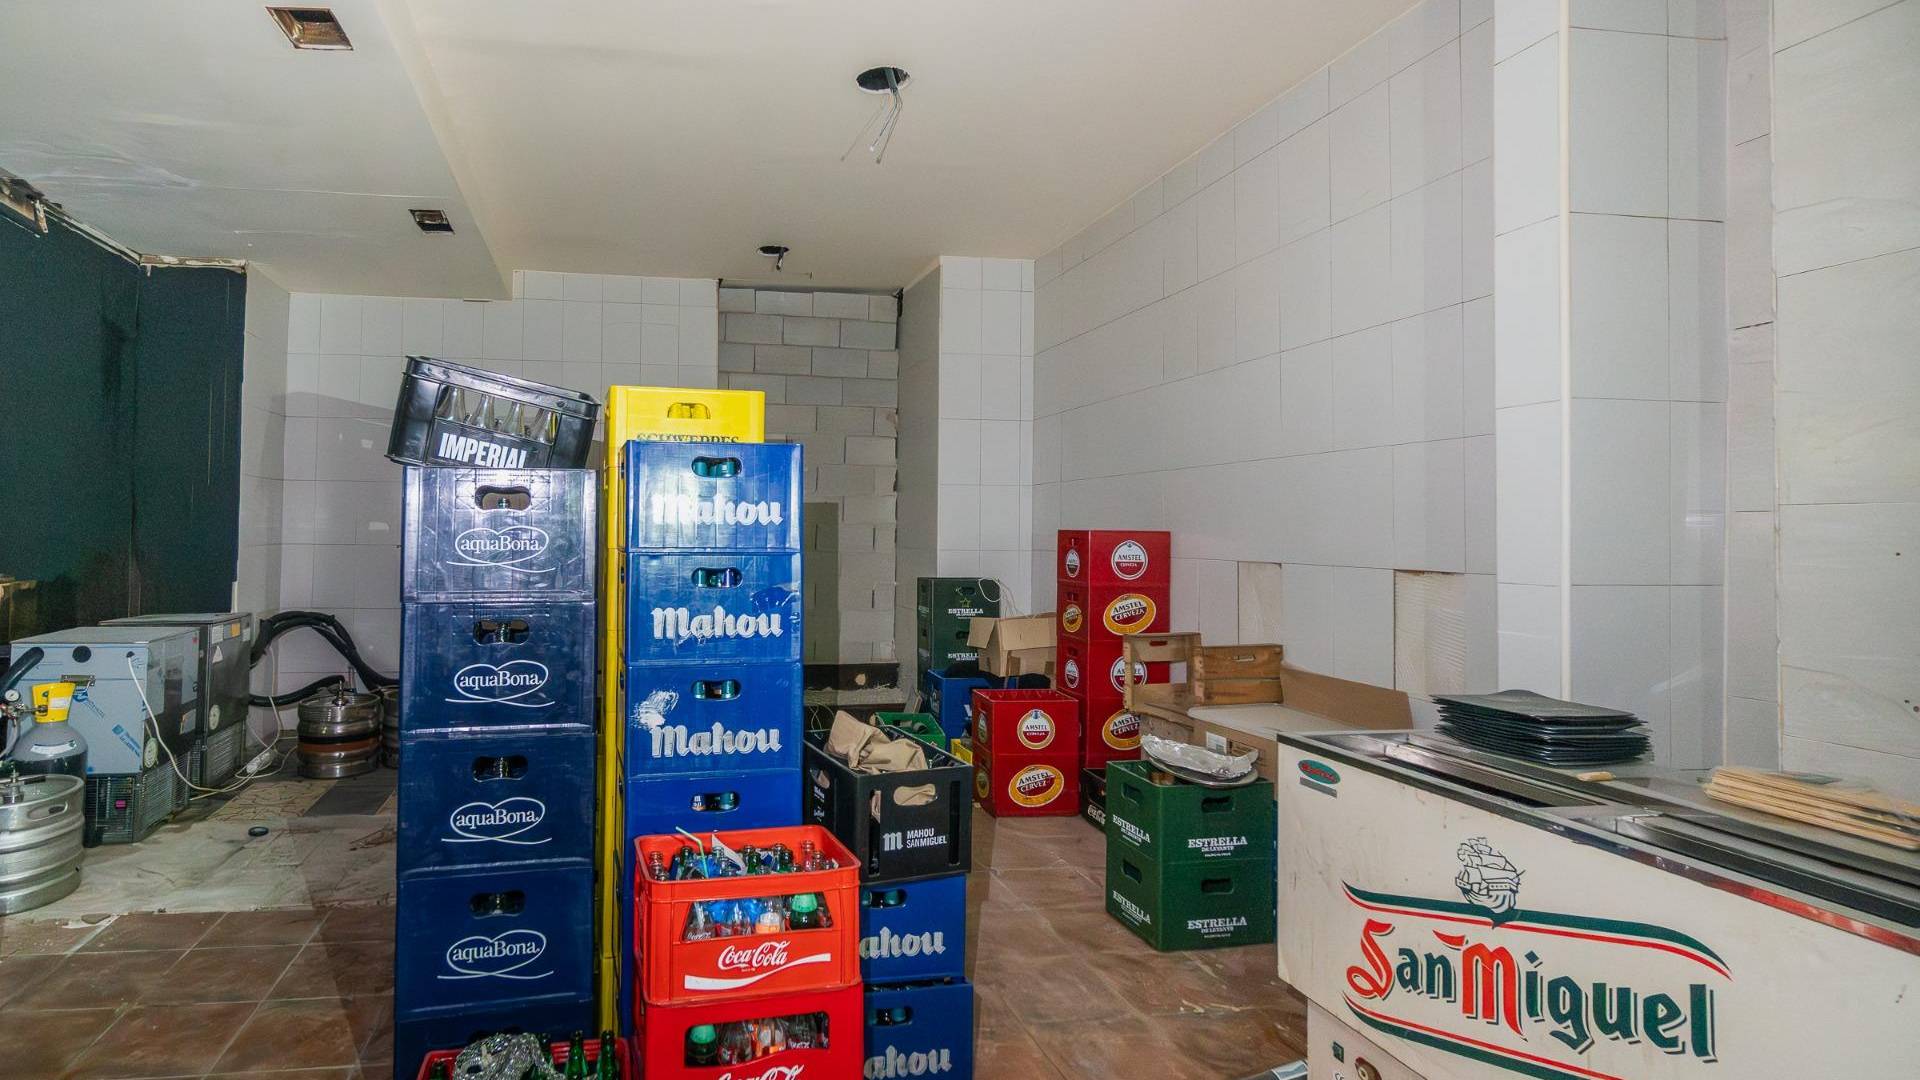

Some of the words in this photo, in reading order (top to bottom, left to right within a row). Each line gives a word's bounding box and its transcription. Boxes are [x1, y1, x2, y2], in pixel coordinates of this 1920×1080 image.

[1113, 601, 1144, 614] AMSTEL
[1114, 609, 1145, 621] CERVEZA
[906, 827, 935, 840] MAHOU
[1188, 836, 1248, 848] ESTRELLA
[1187, 916, 1248, 929] ESTRELLA
[859, 926, 946, 959] ahou
[863, 1045, 952, 1080] ahou
